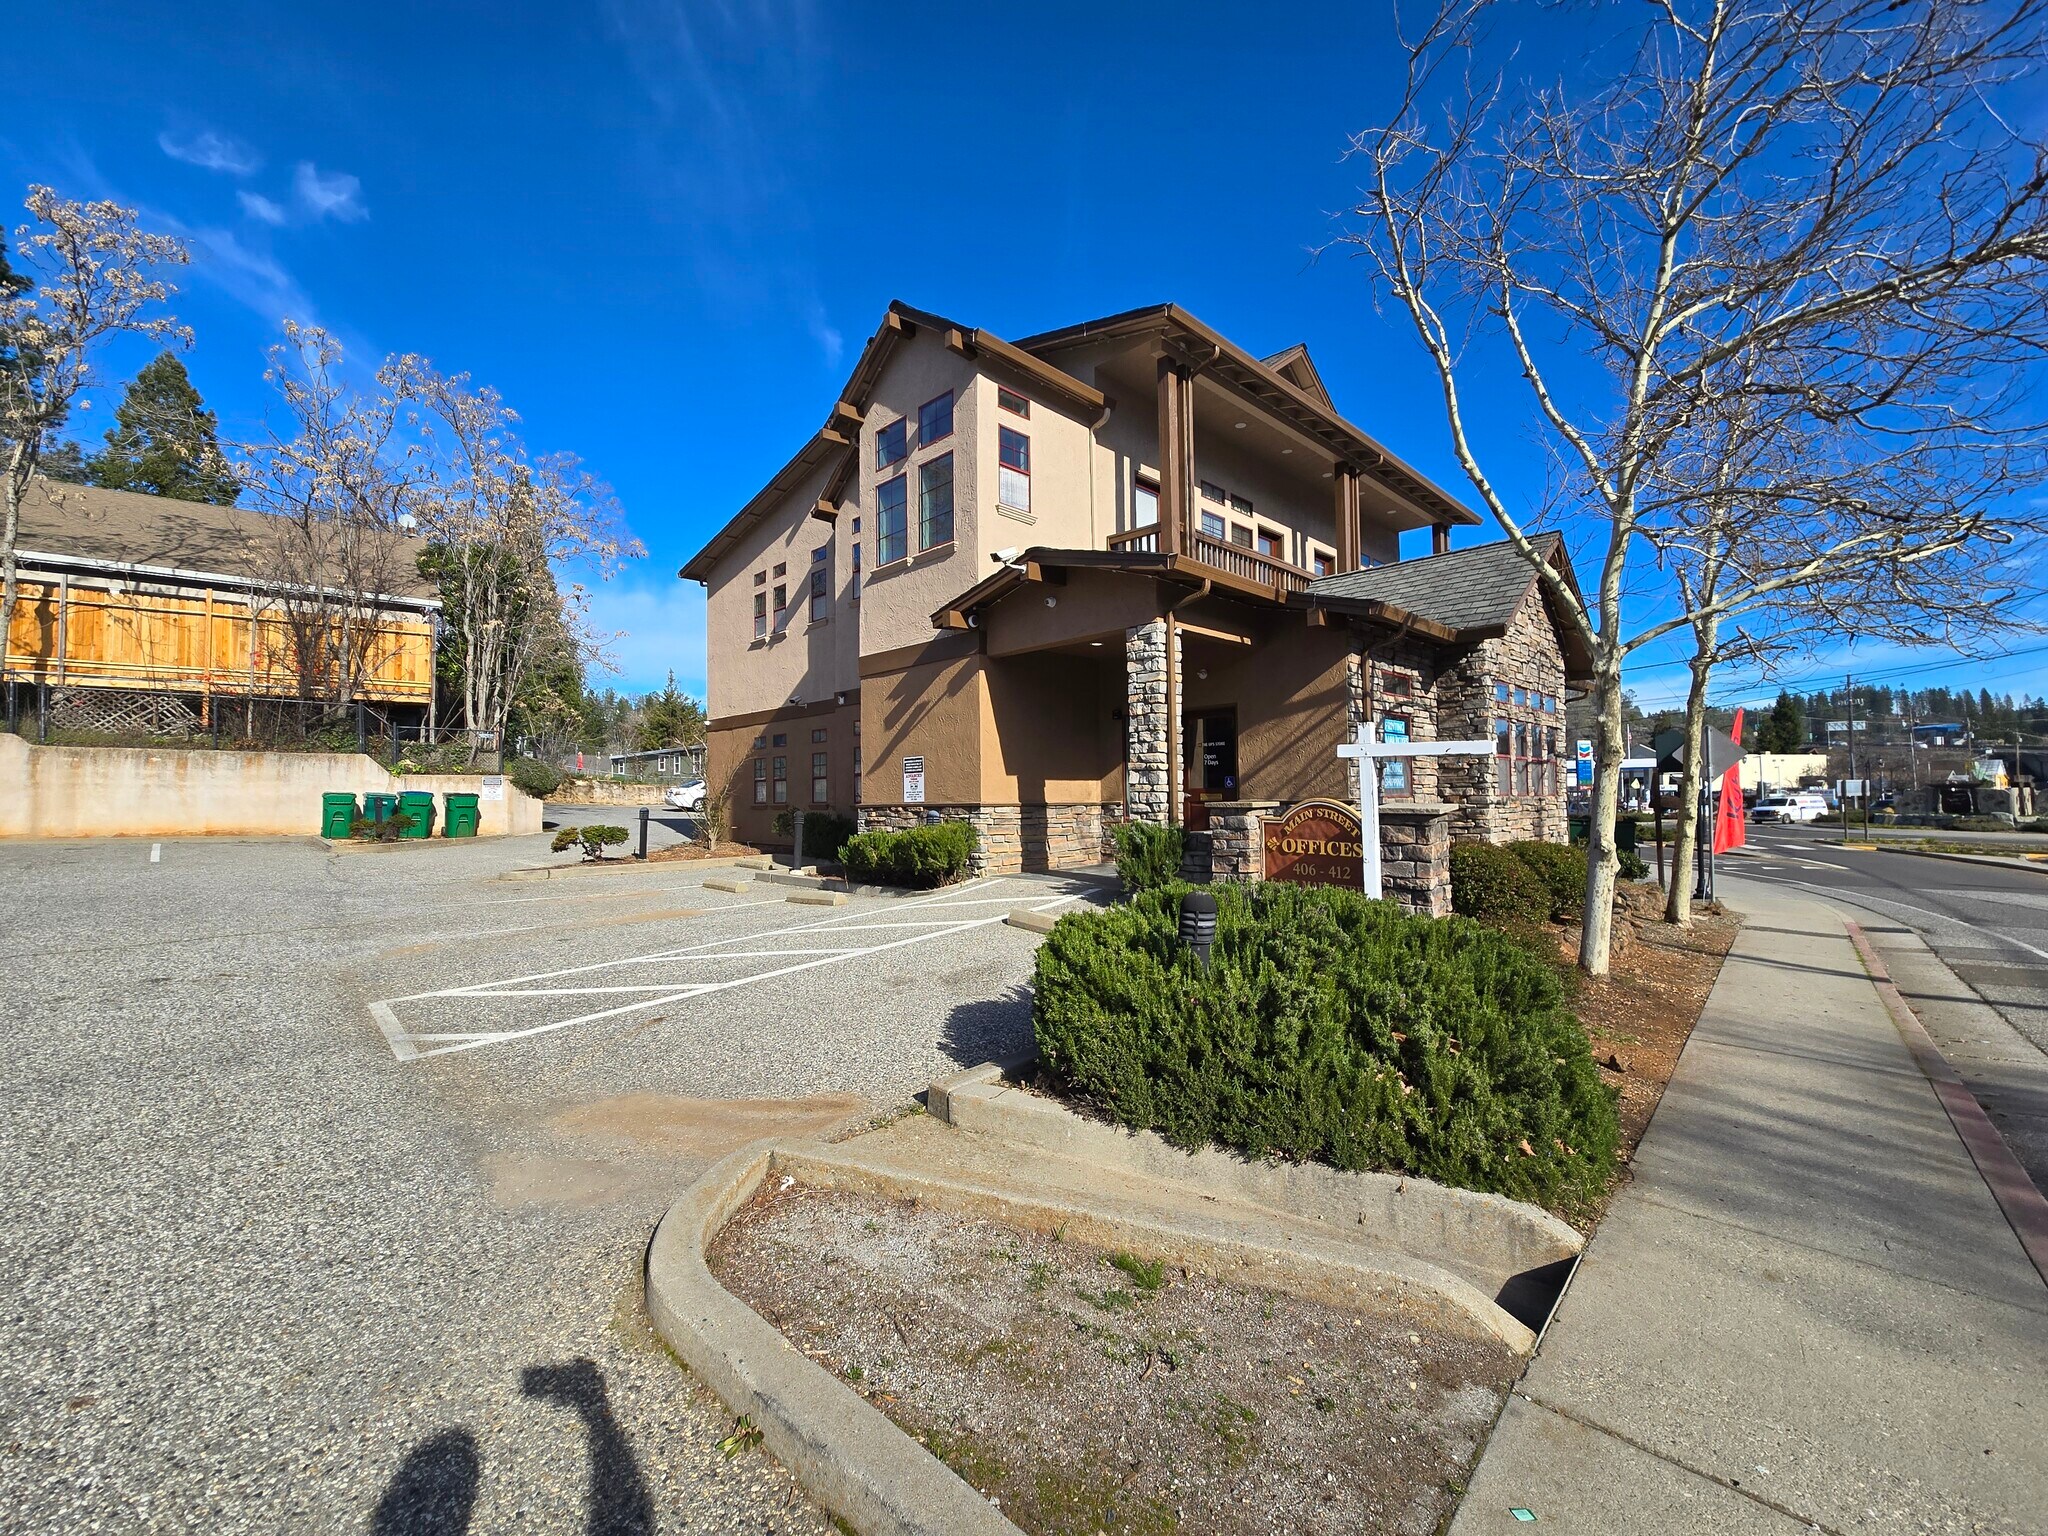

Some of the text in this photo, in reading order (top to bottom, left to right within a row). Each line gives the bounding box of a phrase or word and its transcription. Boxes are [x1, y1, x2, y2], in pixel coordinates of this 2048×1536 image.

[1283, 808, 1361, 838] MAIN STREET
[1281, 838, 1363, 858] OFFICES
[1293, 862, 1316, 876] 406
[1328, 865, 1351, 879] 412
